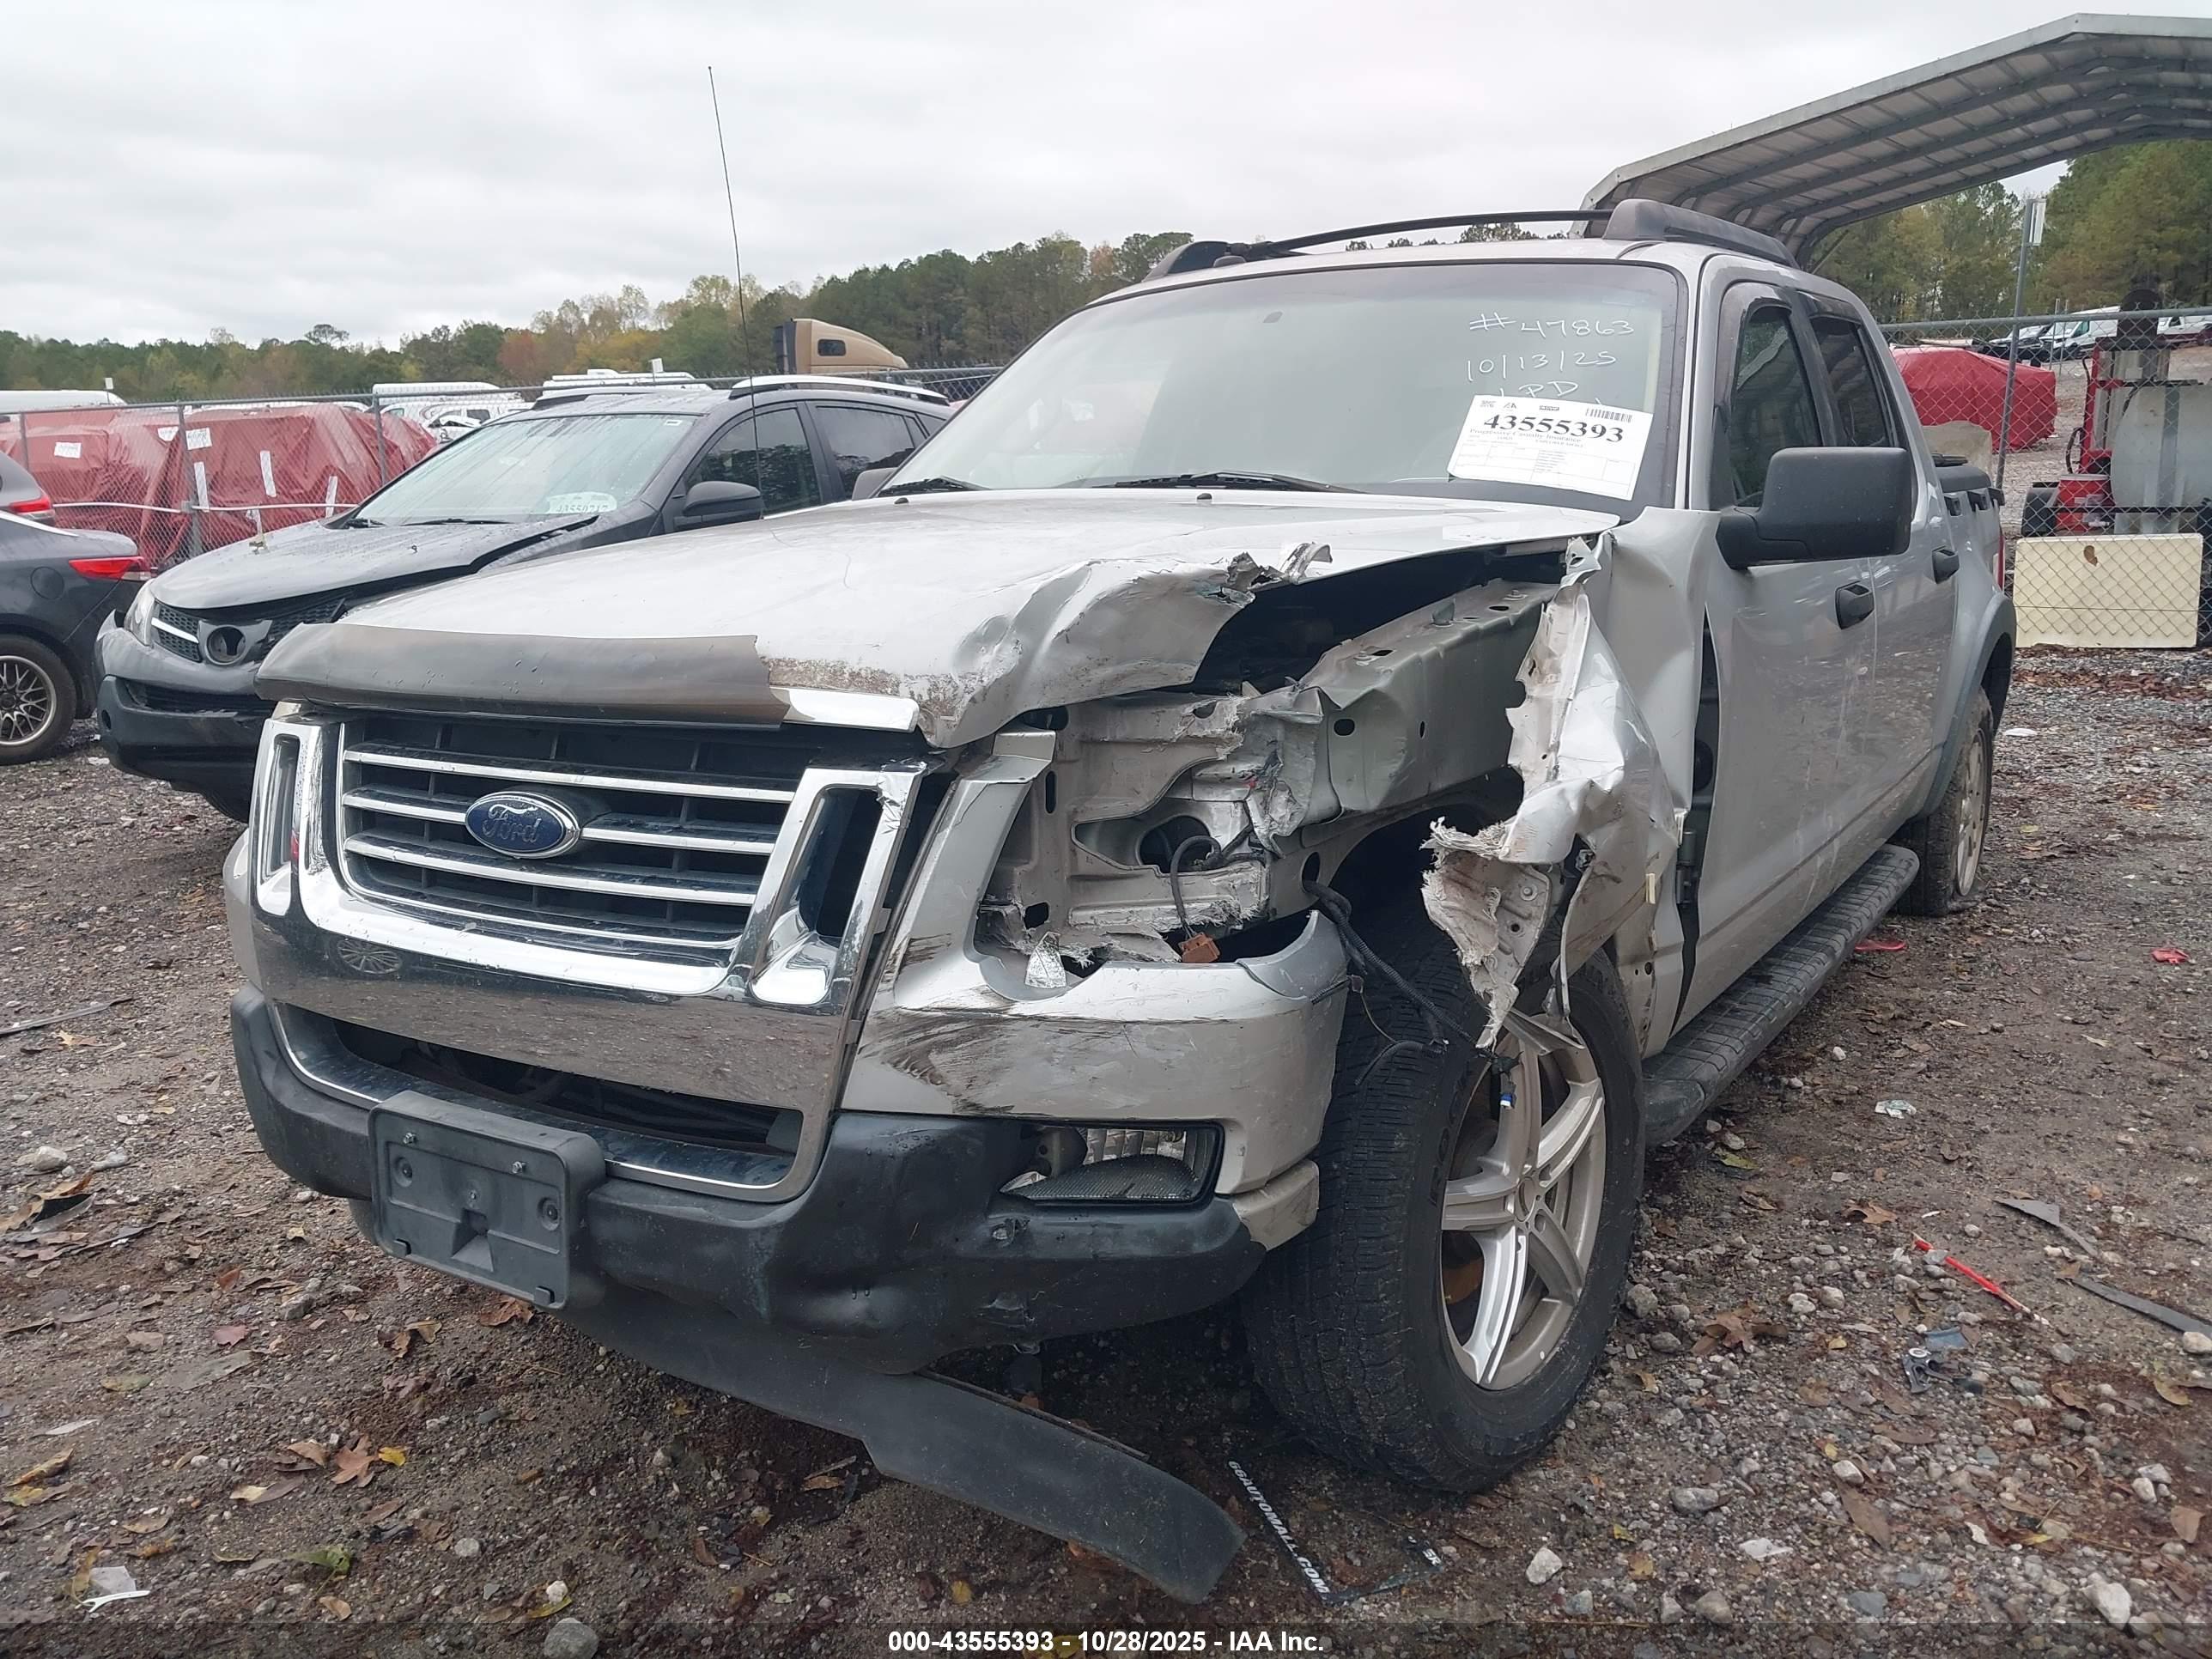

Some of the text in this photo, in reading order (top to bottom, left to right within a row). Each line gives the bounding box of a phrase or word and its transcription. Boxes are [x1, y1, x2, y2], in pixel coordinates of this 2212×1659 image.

[1467, 350, 1617, 381] 10/13/25
[1484, 414, 1624, 443] 43555393
[483, 804, 541, 842] Ford
